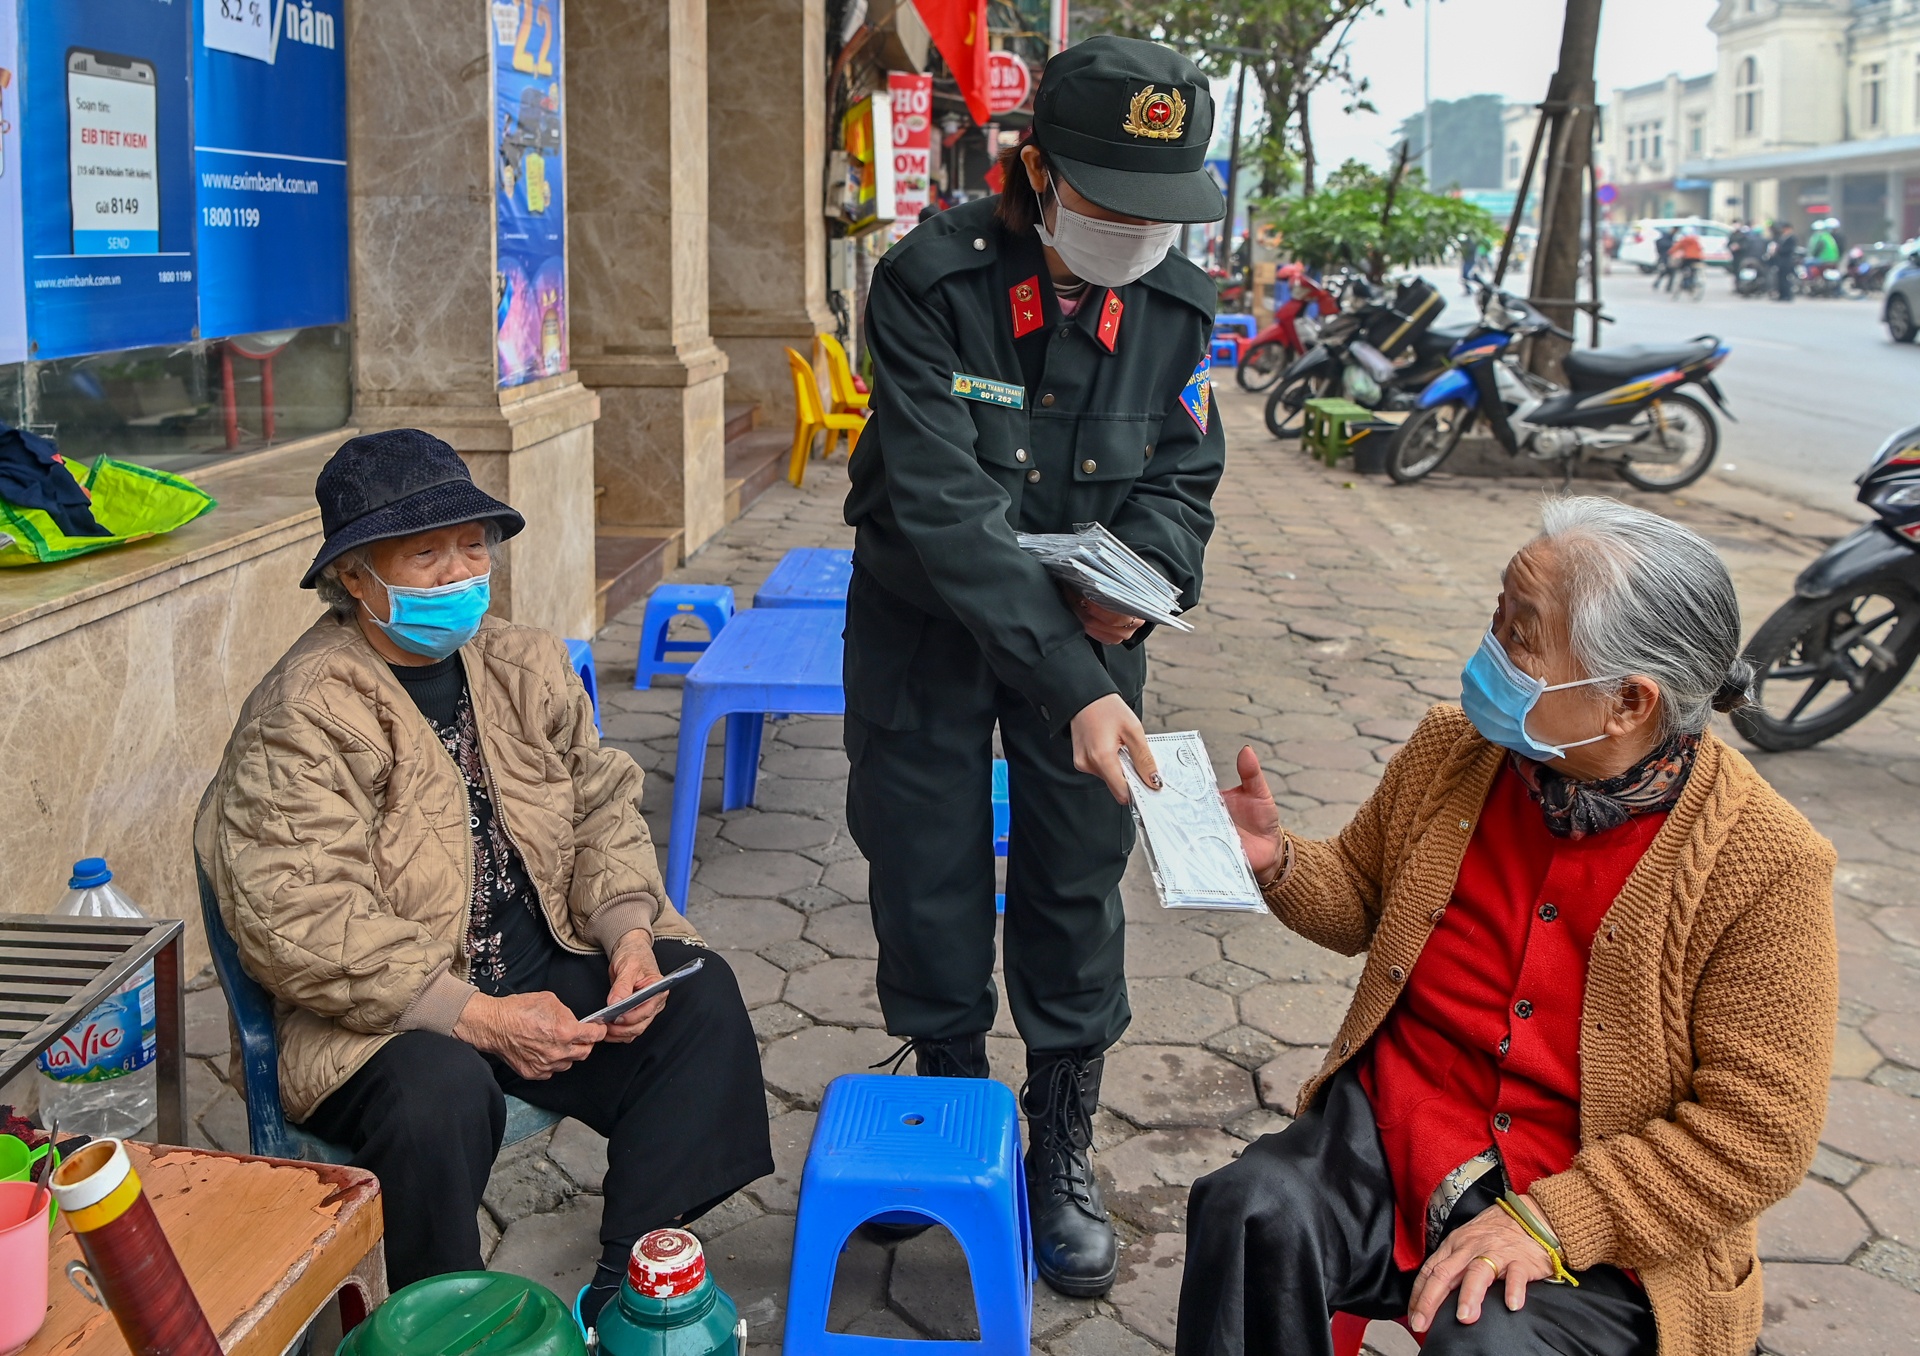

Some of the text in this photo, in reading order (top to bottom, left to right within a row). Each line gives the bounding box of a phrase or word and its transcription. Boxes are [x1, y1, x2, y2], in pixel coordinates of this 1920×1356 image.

[81, 128, 148, 149] EIB TIET KIEM
[201, 171, 319, 195] www.eximbank.com.vn
[111, 197, 139, 215] 8149
[202, 207, 260, 228] 1800 1199
[107, 237, 130, 250] SEND
[34, 273, 121, 289] www.eximbank.com.vn
[158, 270, 192, 283] 1800 1199
